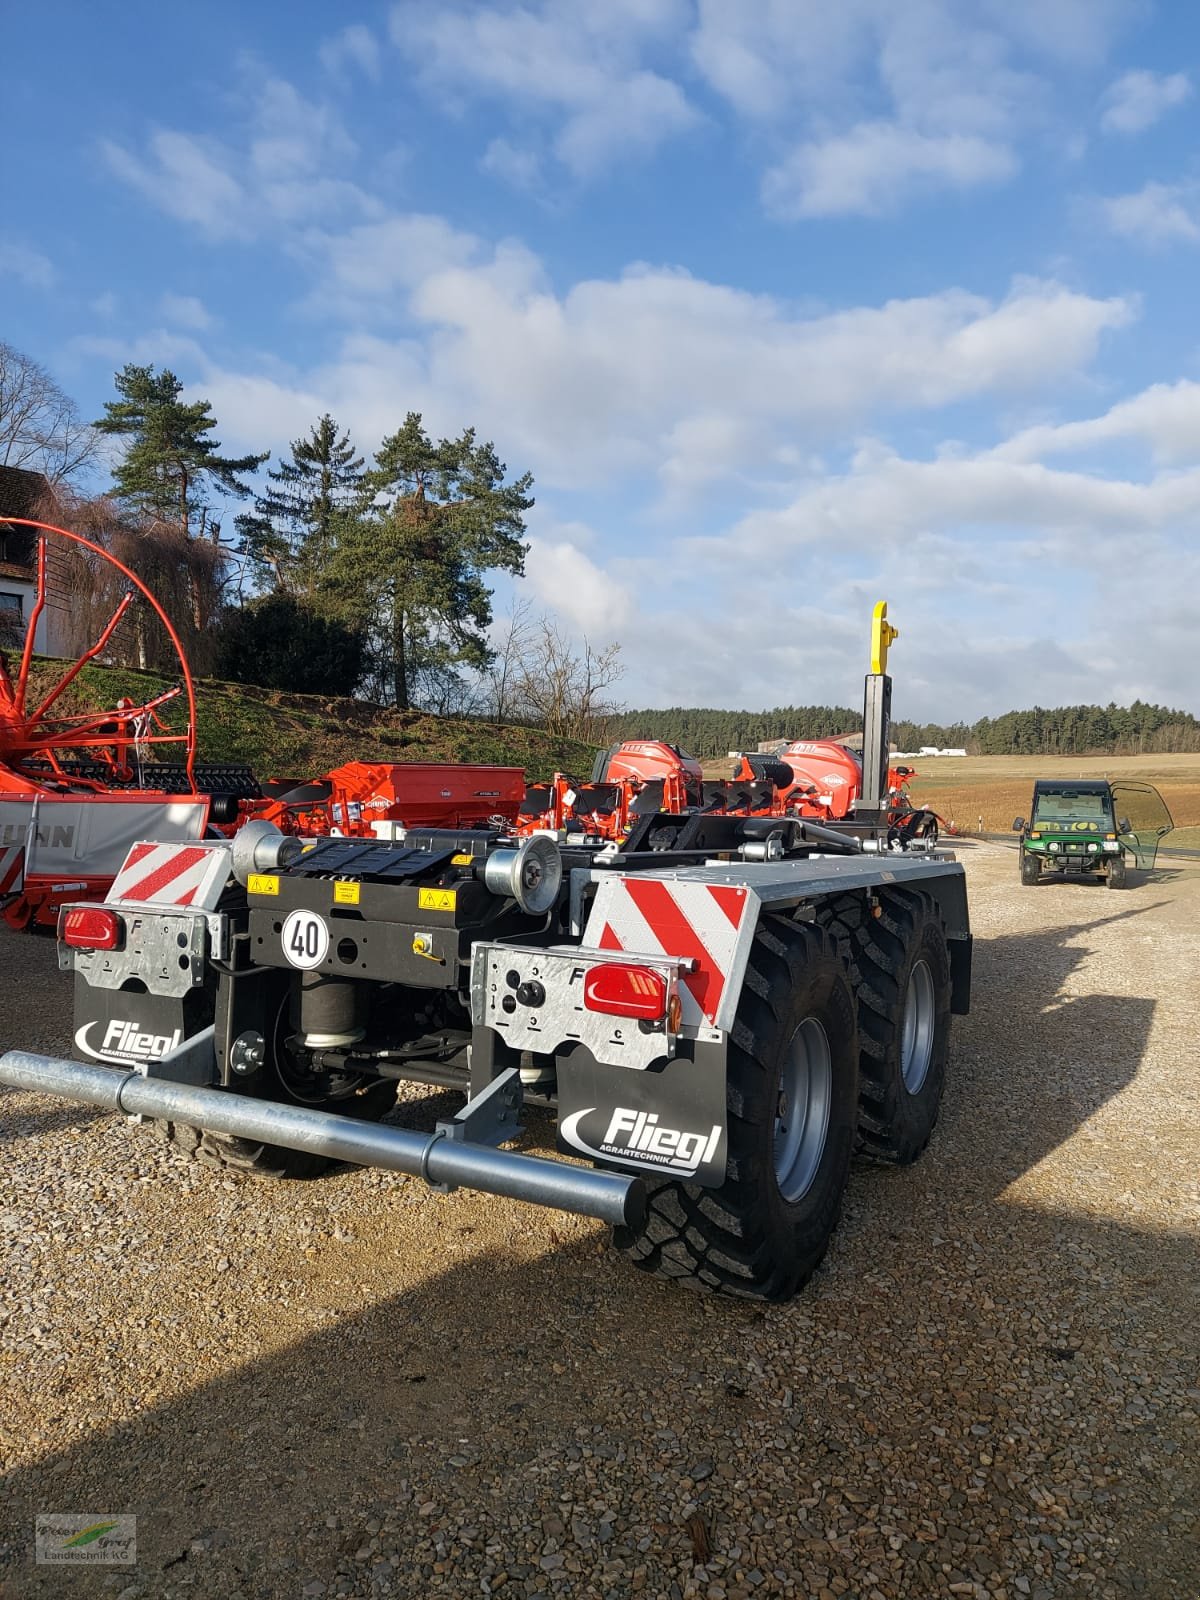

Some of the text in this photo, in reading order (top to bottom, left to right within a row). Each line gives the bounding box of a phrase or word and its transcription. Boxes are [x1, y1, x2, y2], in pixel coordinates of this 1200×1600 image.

[290, 919, 319, 958] 40
[599, 1143, 673, 1165] AGRARTECHNIK
[603, 1107, 723, 1170] Fliegl
